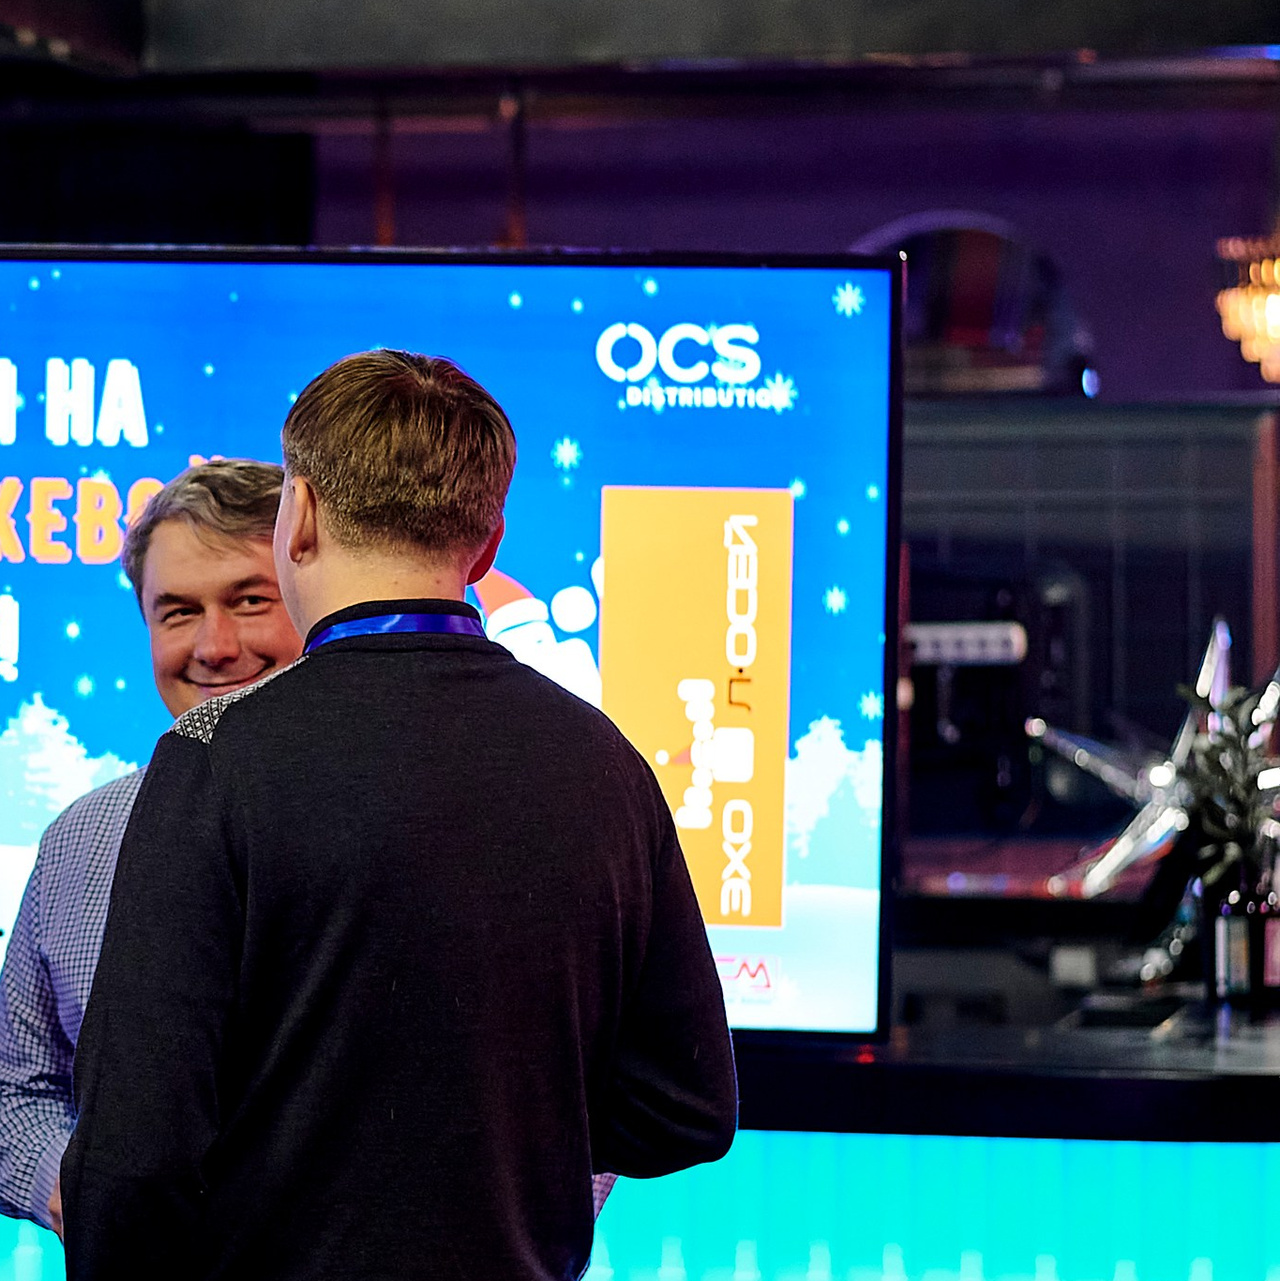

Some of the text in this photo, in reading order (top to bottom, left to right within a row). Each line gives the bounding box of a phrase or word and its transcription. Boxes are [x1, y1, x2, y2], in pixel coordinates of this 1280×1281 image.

[595, 322, 762, 384] OCS
[45, 358, 150, 448] НА
[626, 385, 792, 411] DISTRIBUTIO
